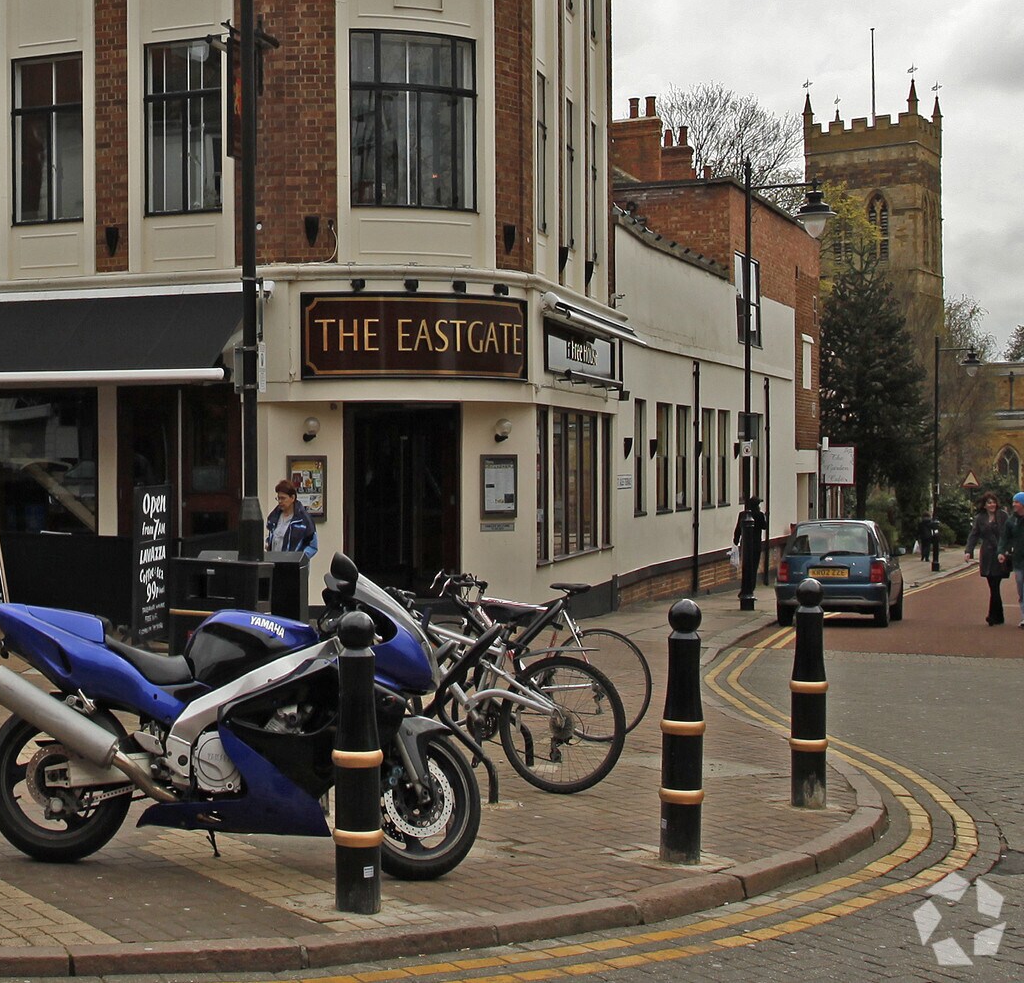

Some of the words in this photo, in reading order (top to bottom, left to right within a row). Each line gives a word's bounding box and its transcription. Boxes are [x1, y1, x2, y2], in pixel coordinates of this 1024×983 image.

[314, 319, 380, 352] THE
[397, 319, 523, 356] EASTGATE
[142, 493, 166, 519] Open
[141, 522, 154, 536] from
[139, 545, 166, 565] LAVAZZA
[139, 567, 154, 585] Coffee
[250, 615, 286, 639] YAMAHA
